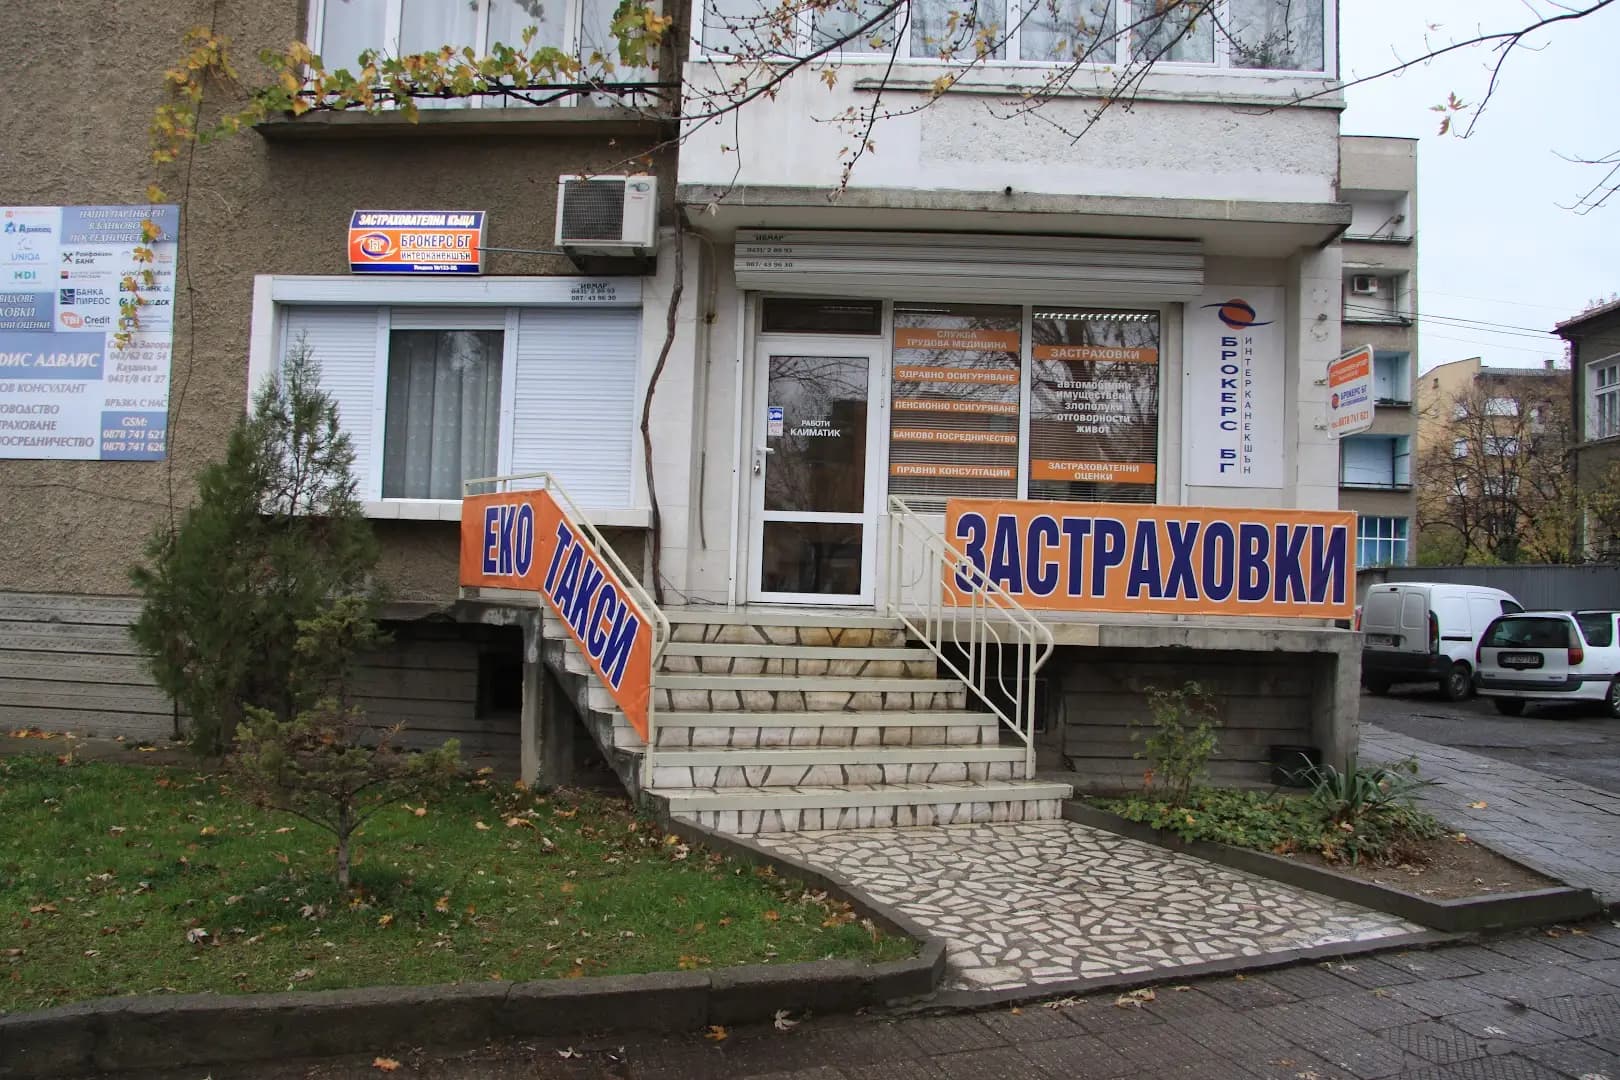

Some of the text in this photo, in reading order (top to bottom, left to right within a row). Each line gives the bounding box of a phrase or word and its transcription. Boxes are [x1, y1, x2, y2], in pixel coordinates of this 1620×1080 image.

[358, 214, 475, 227] ЗАСТРАХОВАТЕЛНА КЪЩА
[401, 234, 472, 249] БРОКЕРС БГ
[14, 271, 36, 280] HDI
[76, 297, 111, 305] ПИРЕОС
[84, 316, 110, 324] Credit
[936, 330, 977, 339] СЛУЖБА
[906, 338, 1008, 350] ТРУДОВА МЕДИЦИНА
[1050, 348, 1140, 360] ЗАСТРАХОВКИ
[899, 370, 1016, 383] ЗДРАВНО ОСИГУРЯВАНЕ
[895, 401, 1017, 414] ПЕНСИОННО ОСИГУРЯВАНЕ
[1219, 336, 1238, 473] БРОКЕРС БГ
[1244, 336, 1253, 475] ИНТЕРКАНЕКШЪН
[801, 420, 830, 428] РАБОТИ
[1057, 414, 1130, 424] отговорности
[790, 428, 840, 438] КЛИМАТИК
[1076, 426, 1110, 434] живот
[893, 431, 1016, 444] БАНКОВО ПОСРЕДНИЧЕСТВО
[896, 466, 1011, 478] ПРАВНИ КОНСУЛТАЦИИ
[1048, 462, 1140, 473] ЗАСТРАХОВАТЕЛНИ
[1074, 472, 1113, 482] ОЦЕНКИ
[482, 502, 535, 578] ЕКО
[953, 511, 1348, 604] ЗАСТРАХОВКИ
[543, 519, 641, 693] ТАКСИ
